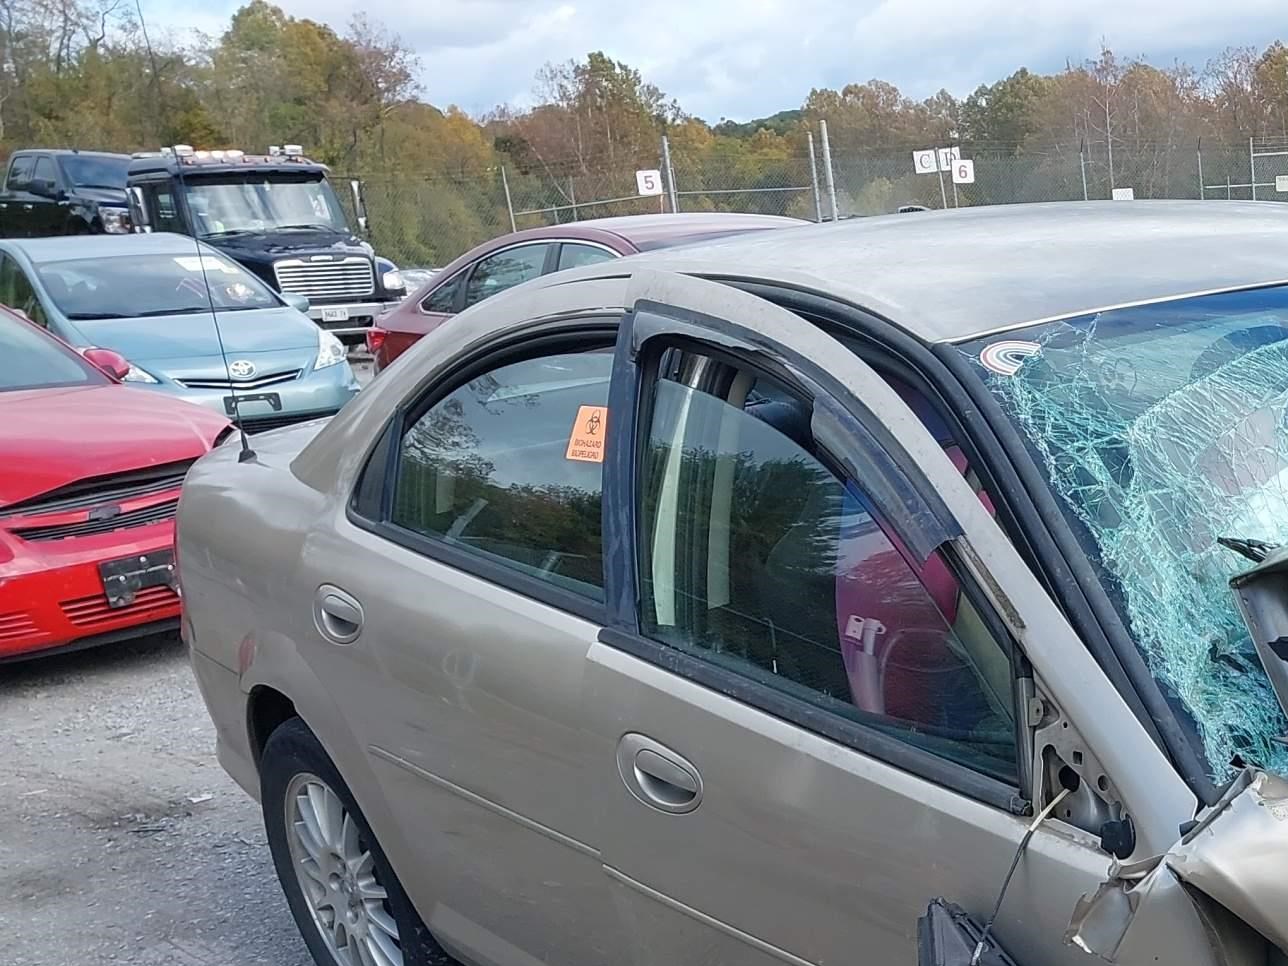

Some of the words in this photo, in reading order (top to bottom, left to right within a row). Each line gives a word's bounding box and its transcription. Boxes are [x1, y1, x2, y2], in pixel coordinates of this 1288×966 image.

[919, 153, 931, 169] C
[958, 164, 968, 179] 6
[643, 175, 655, 190] 5
